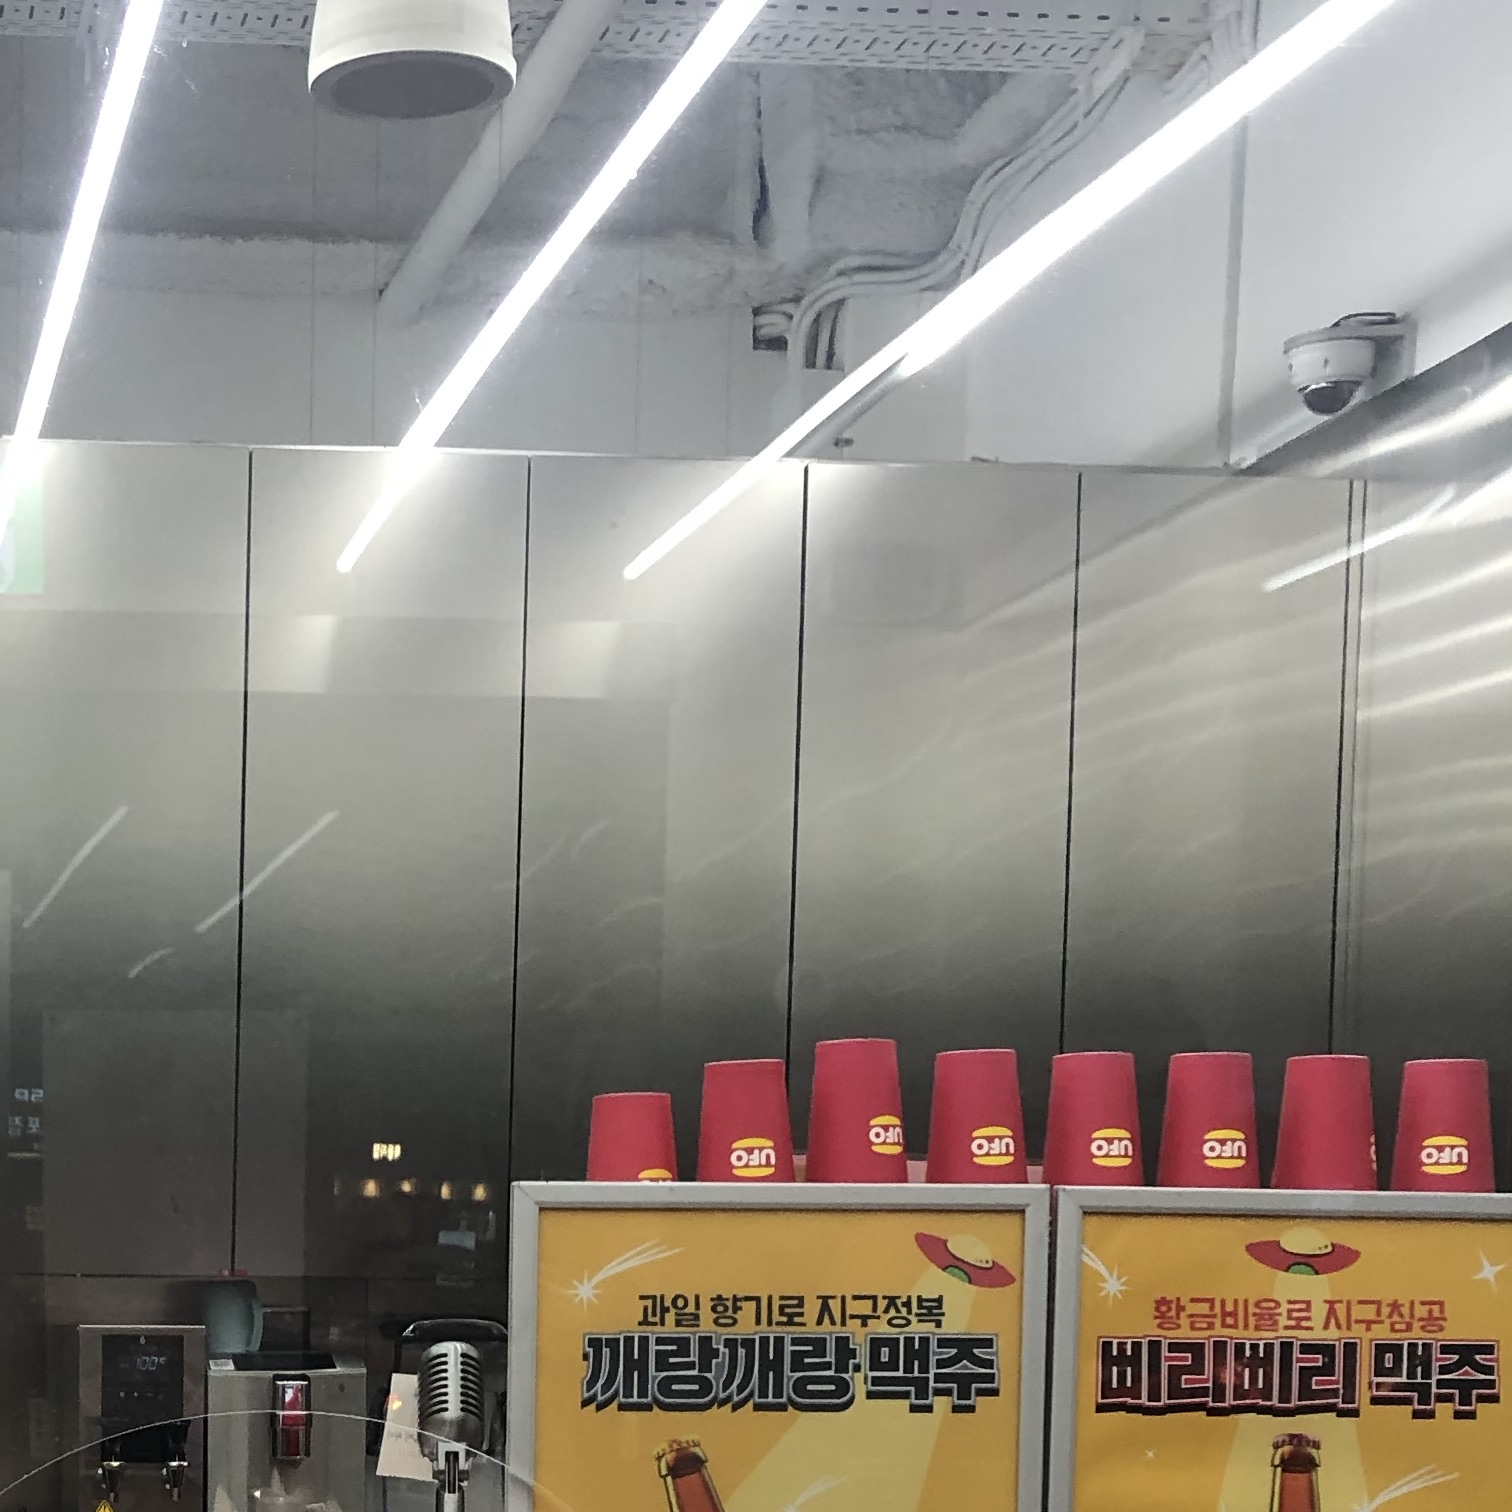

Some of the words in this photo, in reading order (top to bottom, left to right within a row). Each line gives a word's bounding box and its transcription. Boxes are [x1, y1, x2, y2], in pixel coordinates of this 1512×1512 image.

[971, 1137, 1014, 1154] UFO
[1091, 1139, 1133, 1156] UFO
[1203, 1140, 1247, 1157] UFO
[730, 1148, 775, 1166] UFO
[1421, 1147, 1469, 1163] UFO
[638, 1294, 701, 1328] 과일
[709, 1294, 807, 1328] 향기로
[816, 1294, 947, 1328] 지구정복
[1153, 1297, 1315, 1332] 황금비율로
[1322, 1298, 1448, 1333] 지구침공
[580, 1332, 862, 1413] 깨랑깨랑
[864, 1332, 1000, 1414] 맥주
[1095, 1335, 1363, 1418] 삐리삐리
[1369, 1337, 1501, 1420] 맥주
